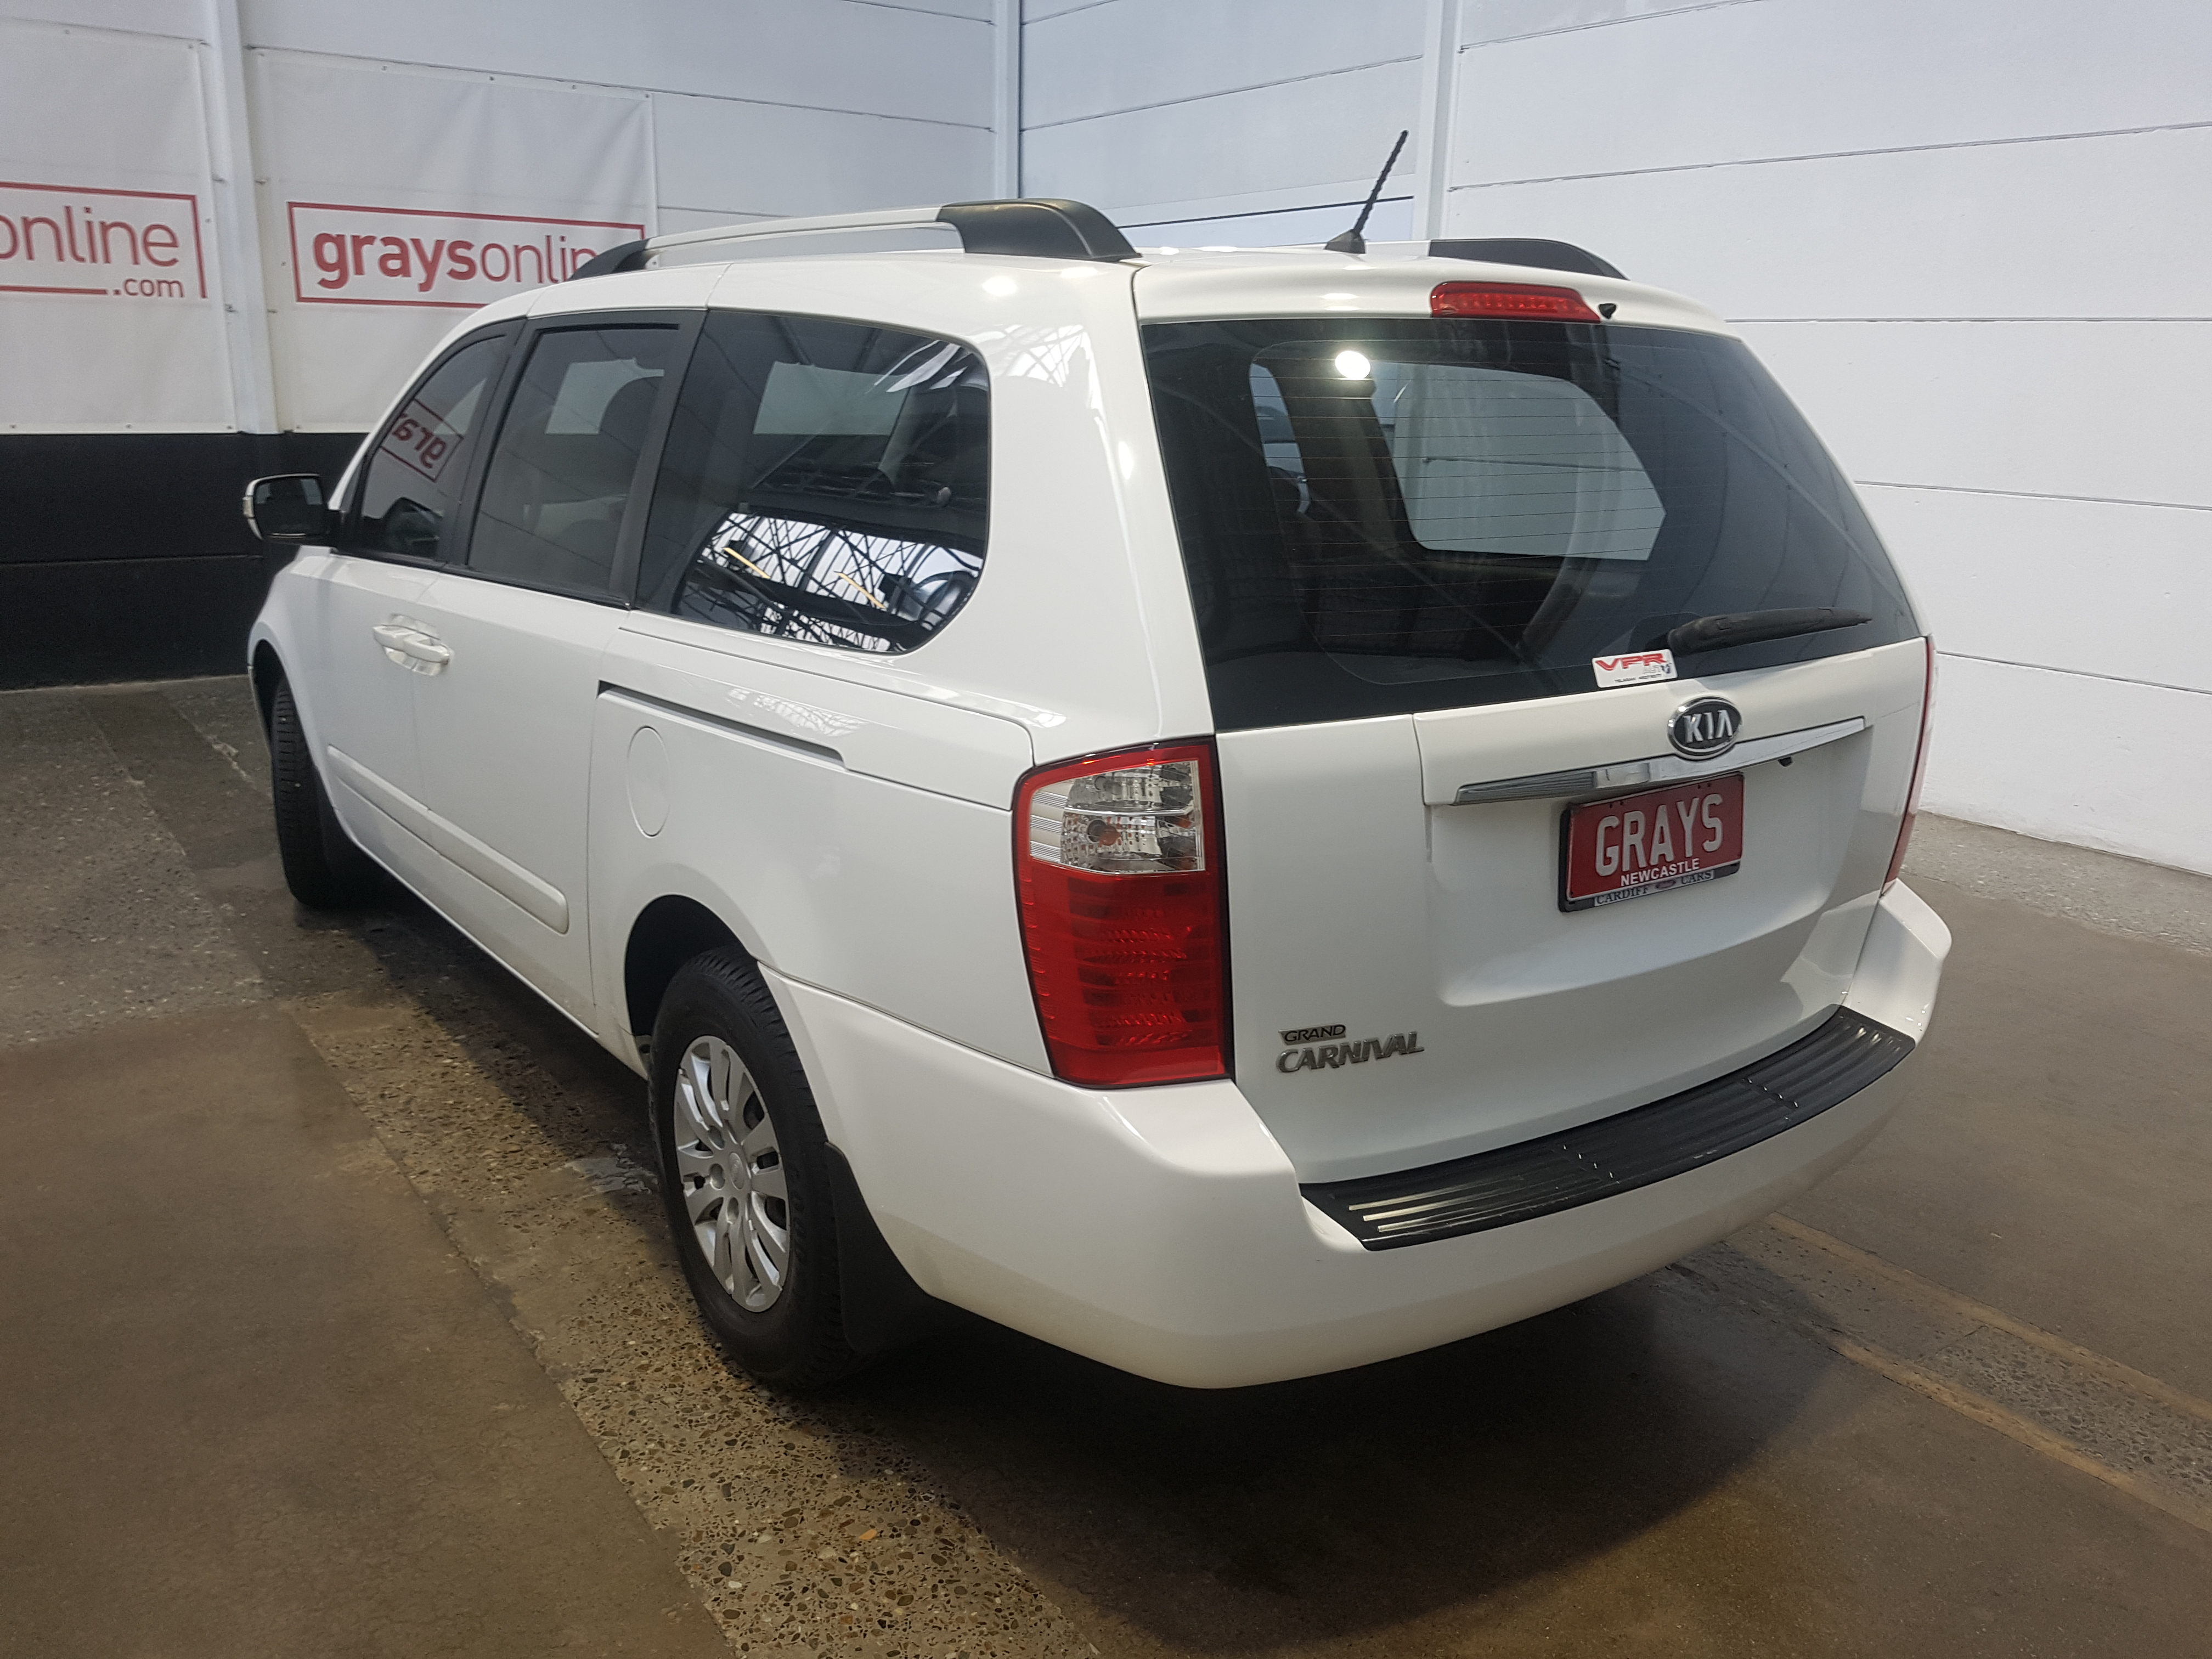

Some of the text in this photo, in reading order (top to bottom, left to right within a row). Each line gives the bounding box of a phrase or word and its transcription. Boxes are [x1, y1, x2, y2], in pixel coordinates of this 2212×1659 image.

[313, 231, 598, 293] graysonlin
[1595, 653, 1667, 671] VPR
[1683, 710, 1734, 744] KIA
[1595, 793, 1723, 877] GRAYS
[1621, 858, 1700, 887] NEWCASTLE
[1596, 885, 1649, 905] CARDIFF
[1284, 1024, 1346, 1042] GRAND
[1276, 1031, 1425, 1073] CARNIVAL
